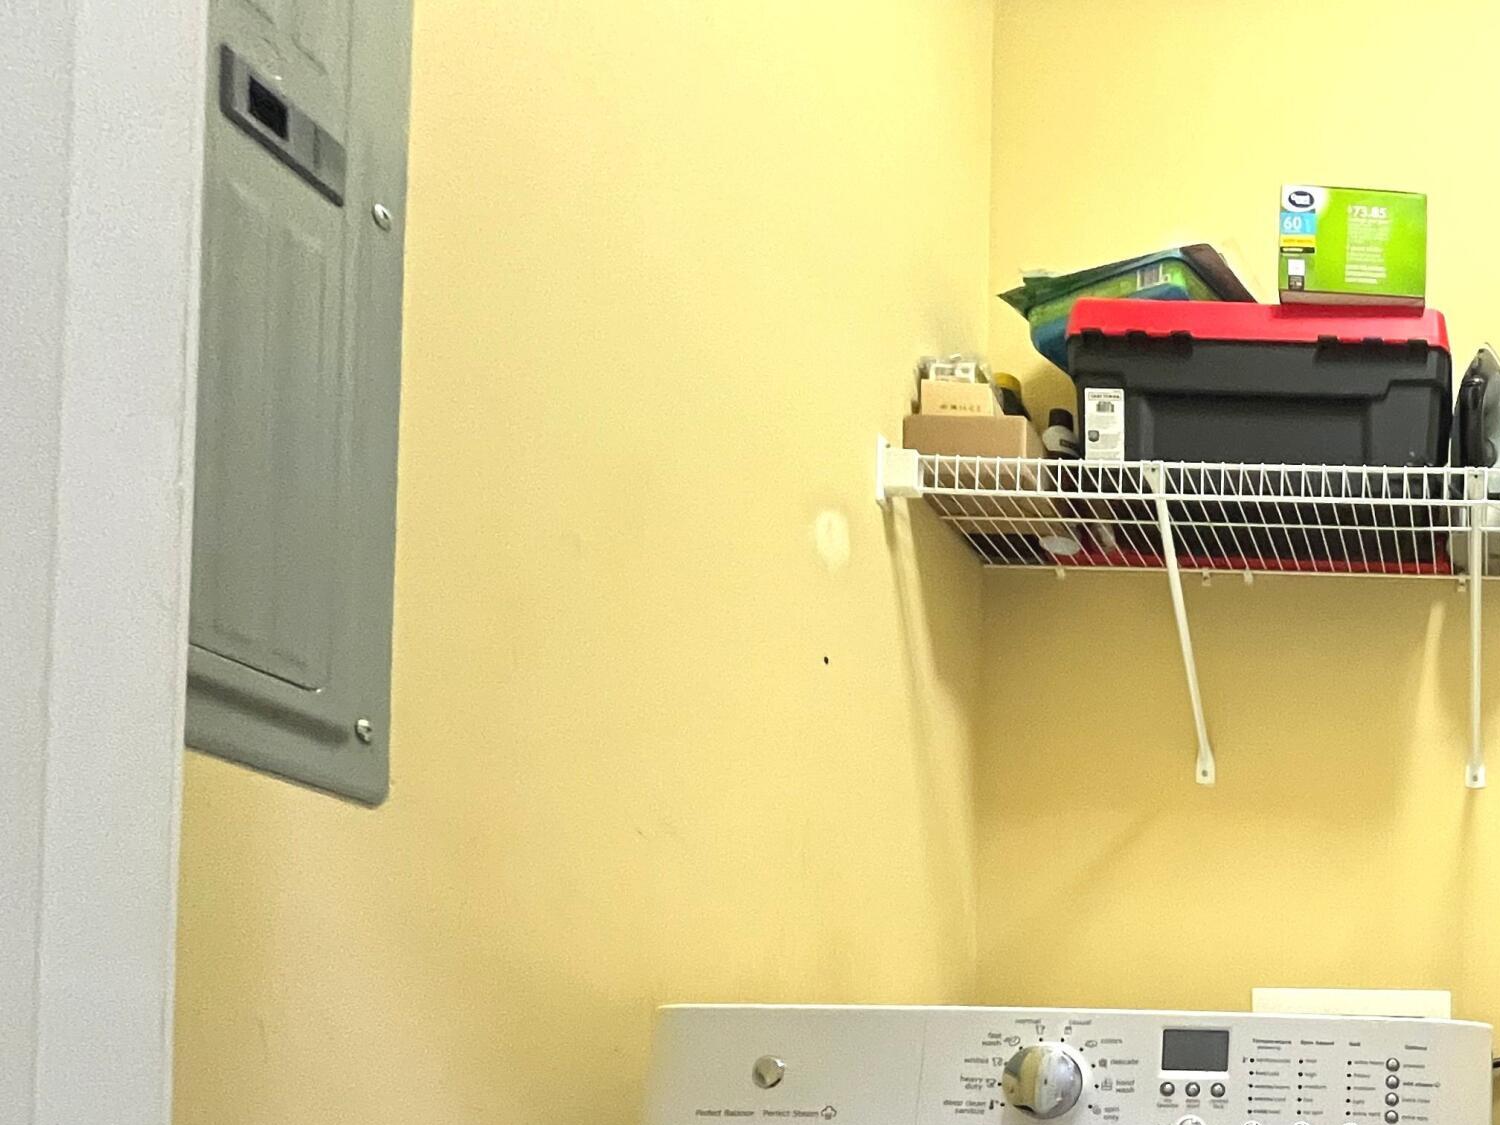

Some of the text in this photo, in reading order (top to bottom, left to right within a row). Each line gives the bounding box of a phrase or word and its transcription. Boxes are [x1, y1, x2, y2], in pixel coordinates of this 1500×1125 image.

[1283, 216, 1303, 231] 60
[762, 1108, 820, 1119] Perfect Steam
